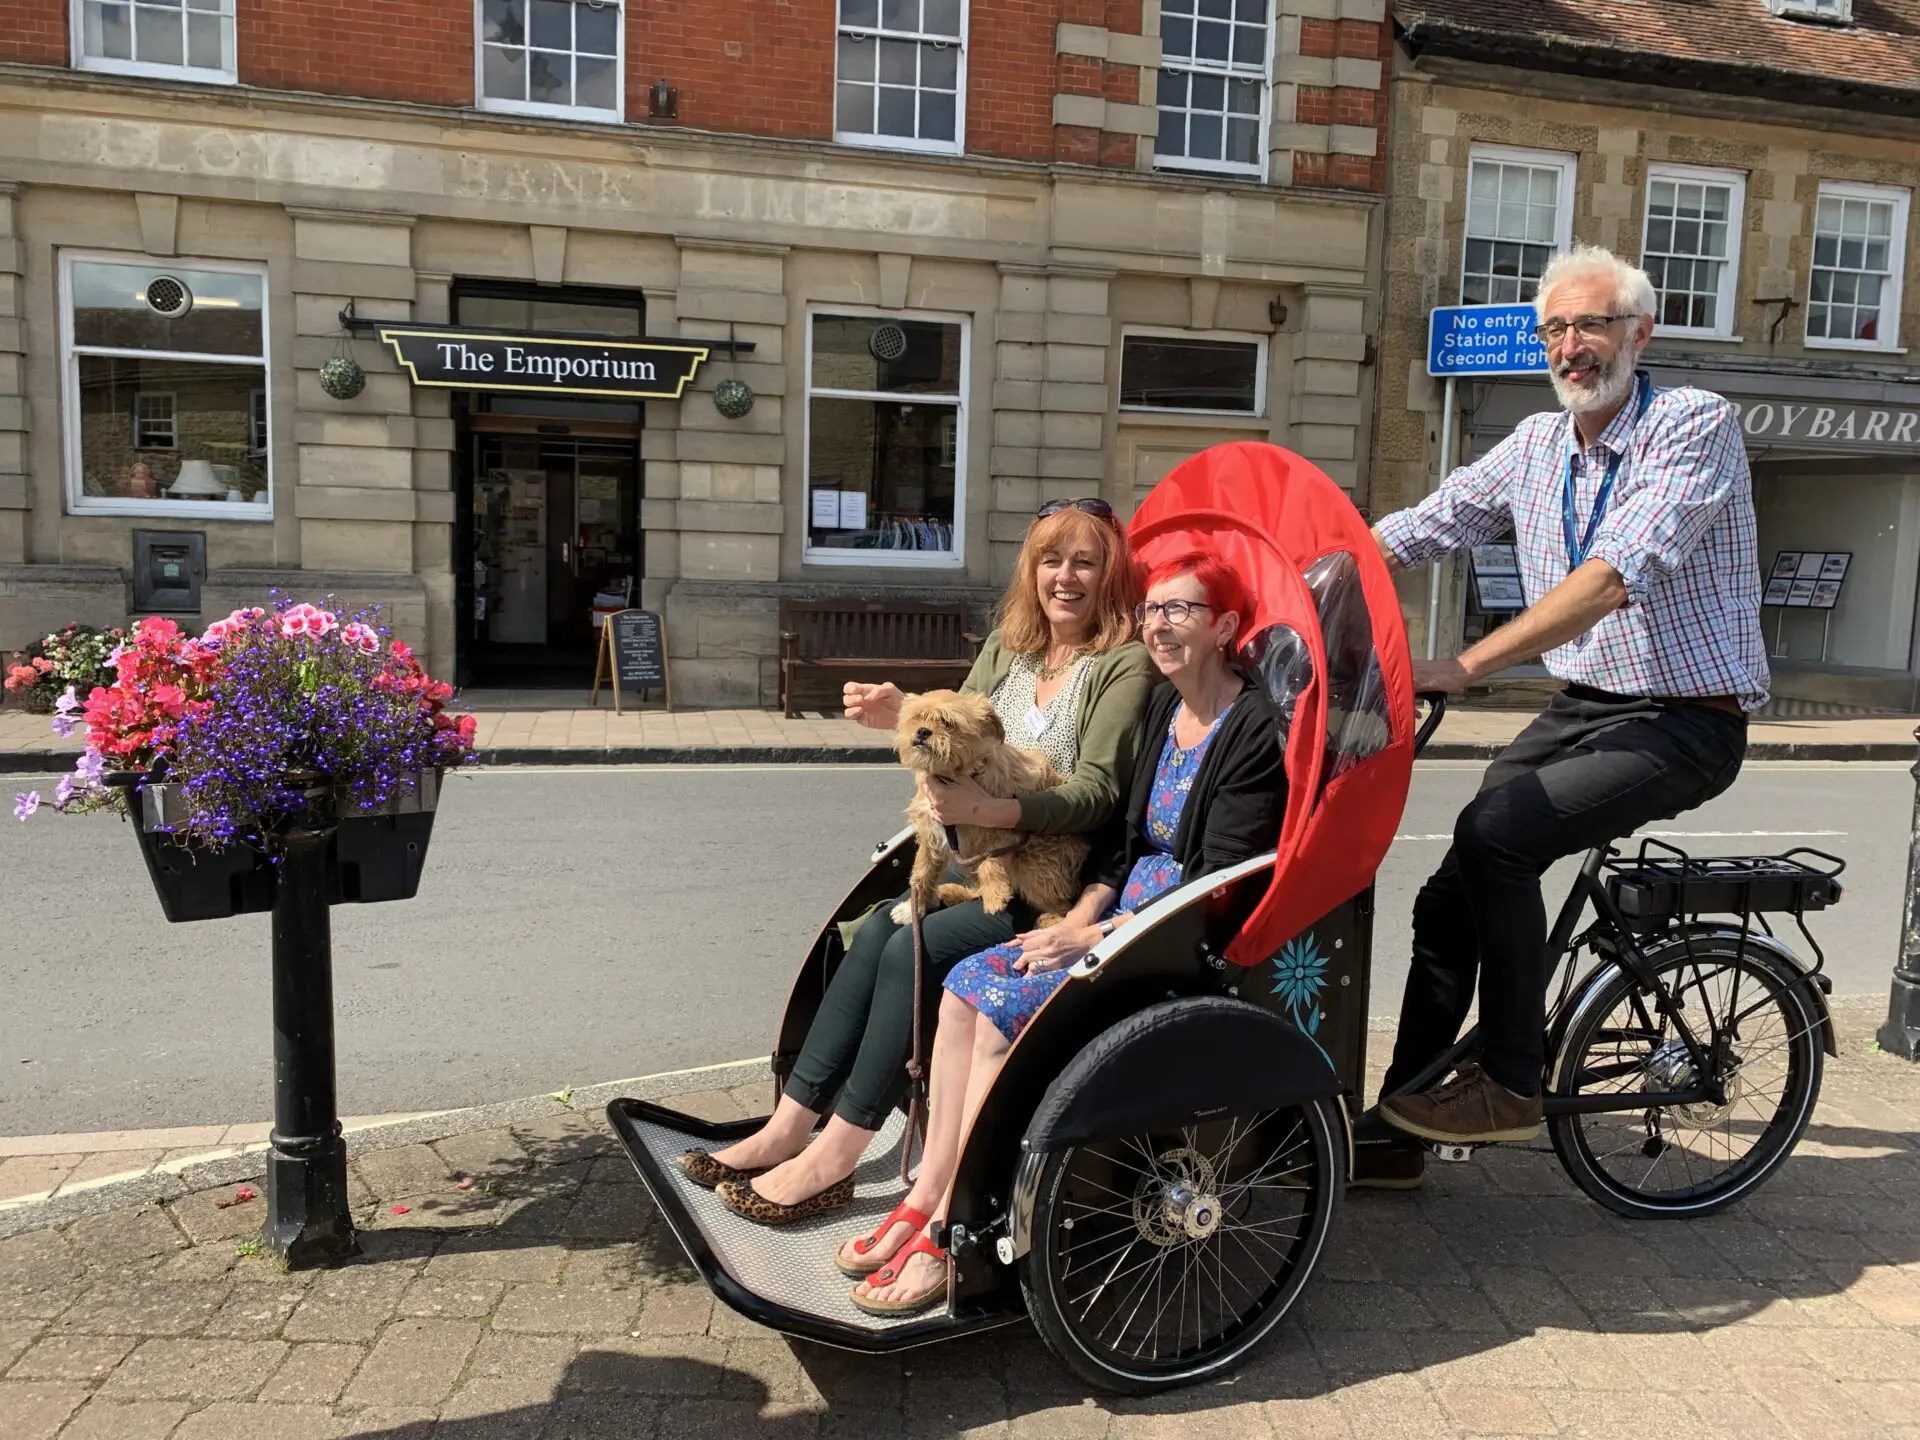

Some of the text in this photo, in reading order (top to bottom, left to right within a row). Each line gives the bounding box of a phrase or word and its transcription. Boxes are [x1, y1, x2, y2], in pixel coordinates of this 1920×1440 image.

[457, 153, 633, 207] BANK
[1453, 313, 1530, 329] No entry
[1444, 332, 1508, 348] Station
[437, 343, 656, 382] The Emporium
[1437, 350, 1548, 367] (second righ
[1805, 407, 1920, 444] BARR
